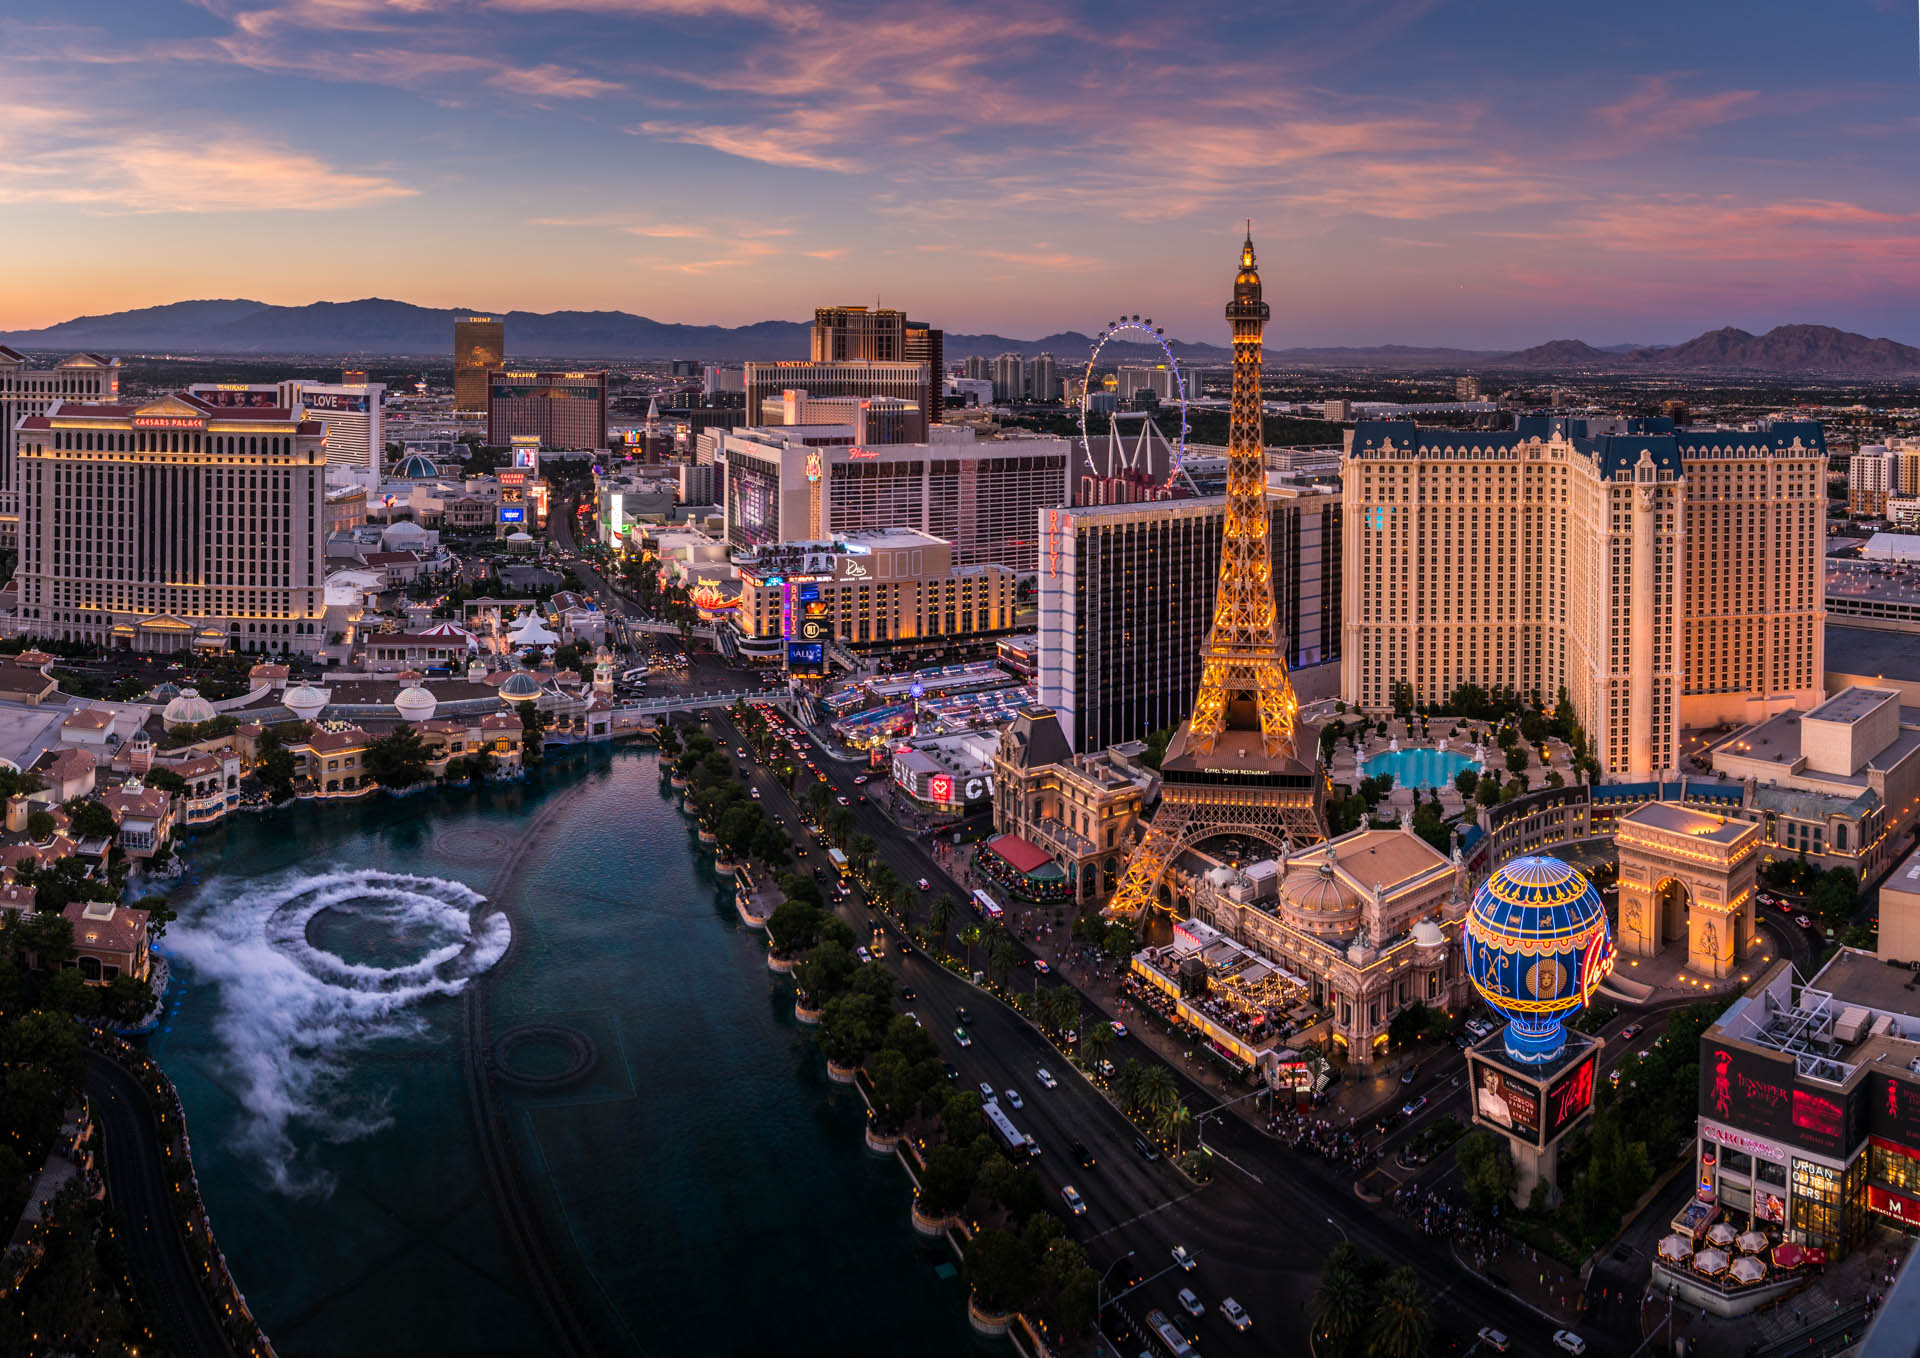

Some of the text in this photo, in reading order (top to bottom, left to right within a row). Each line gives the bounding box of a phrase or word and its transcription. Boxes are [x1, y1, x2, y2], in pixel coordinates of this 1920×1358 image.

[313, 395, 338, 408] LOVE
[135, 417, 169, 426] CAESARS
[1792, 1159, 1833, 1180] URBAN
[1793, 1183, 1820, 1200] TERS
[1889, 1198, 1901, 1214] M
